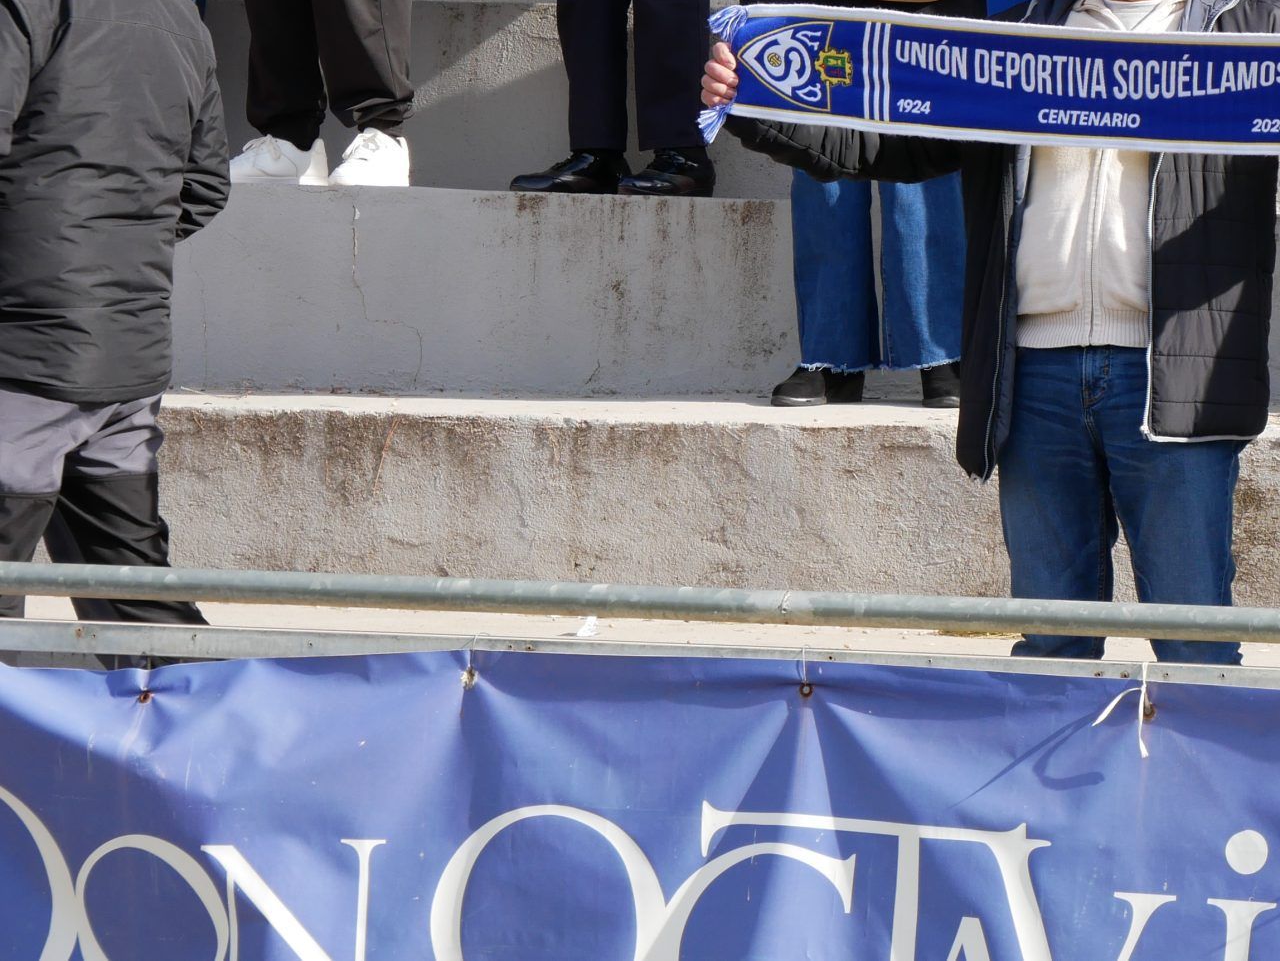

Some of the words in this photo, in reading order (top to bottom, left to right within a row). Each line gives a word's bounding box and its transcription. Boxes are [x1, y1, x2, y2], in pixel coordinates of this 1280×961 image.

[895, 39, 968, 80] UNIÓN
[974, 48, 1107, 99] DEPORTIVA
[896, 98, 931, 115] 1924
[1037, 108, 1141, 129] CENTENARIO
